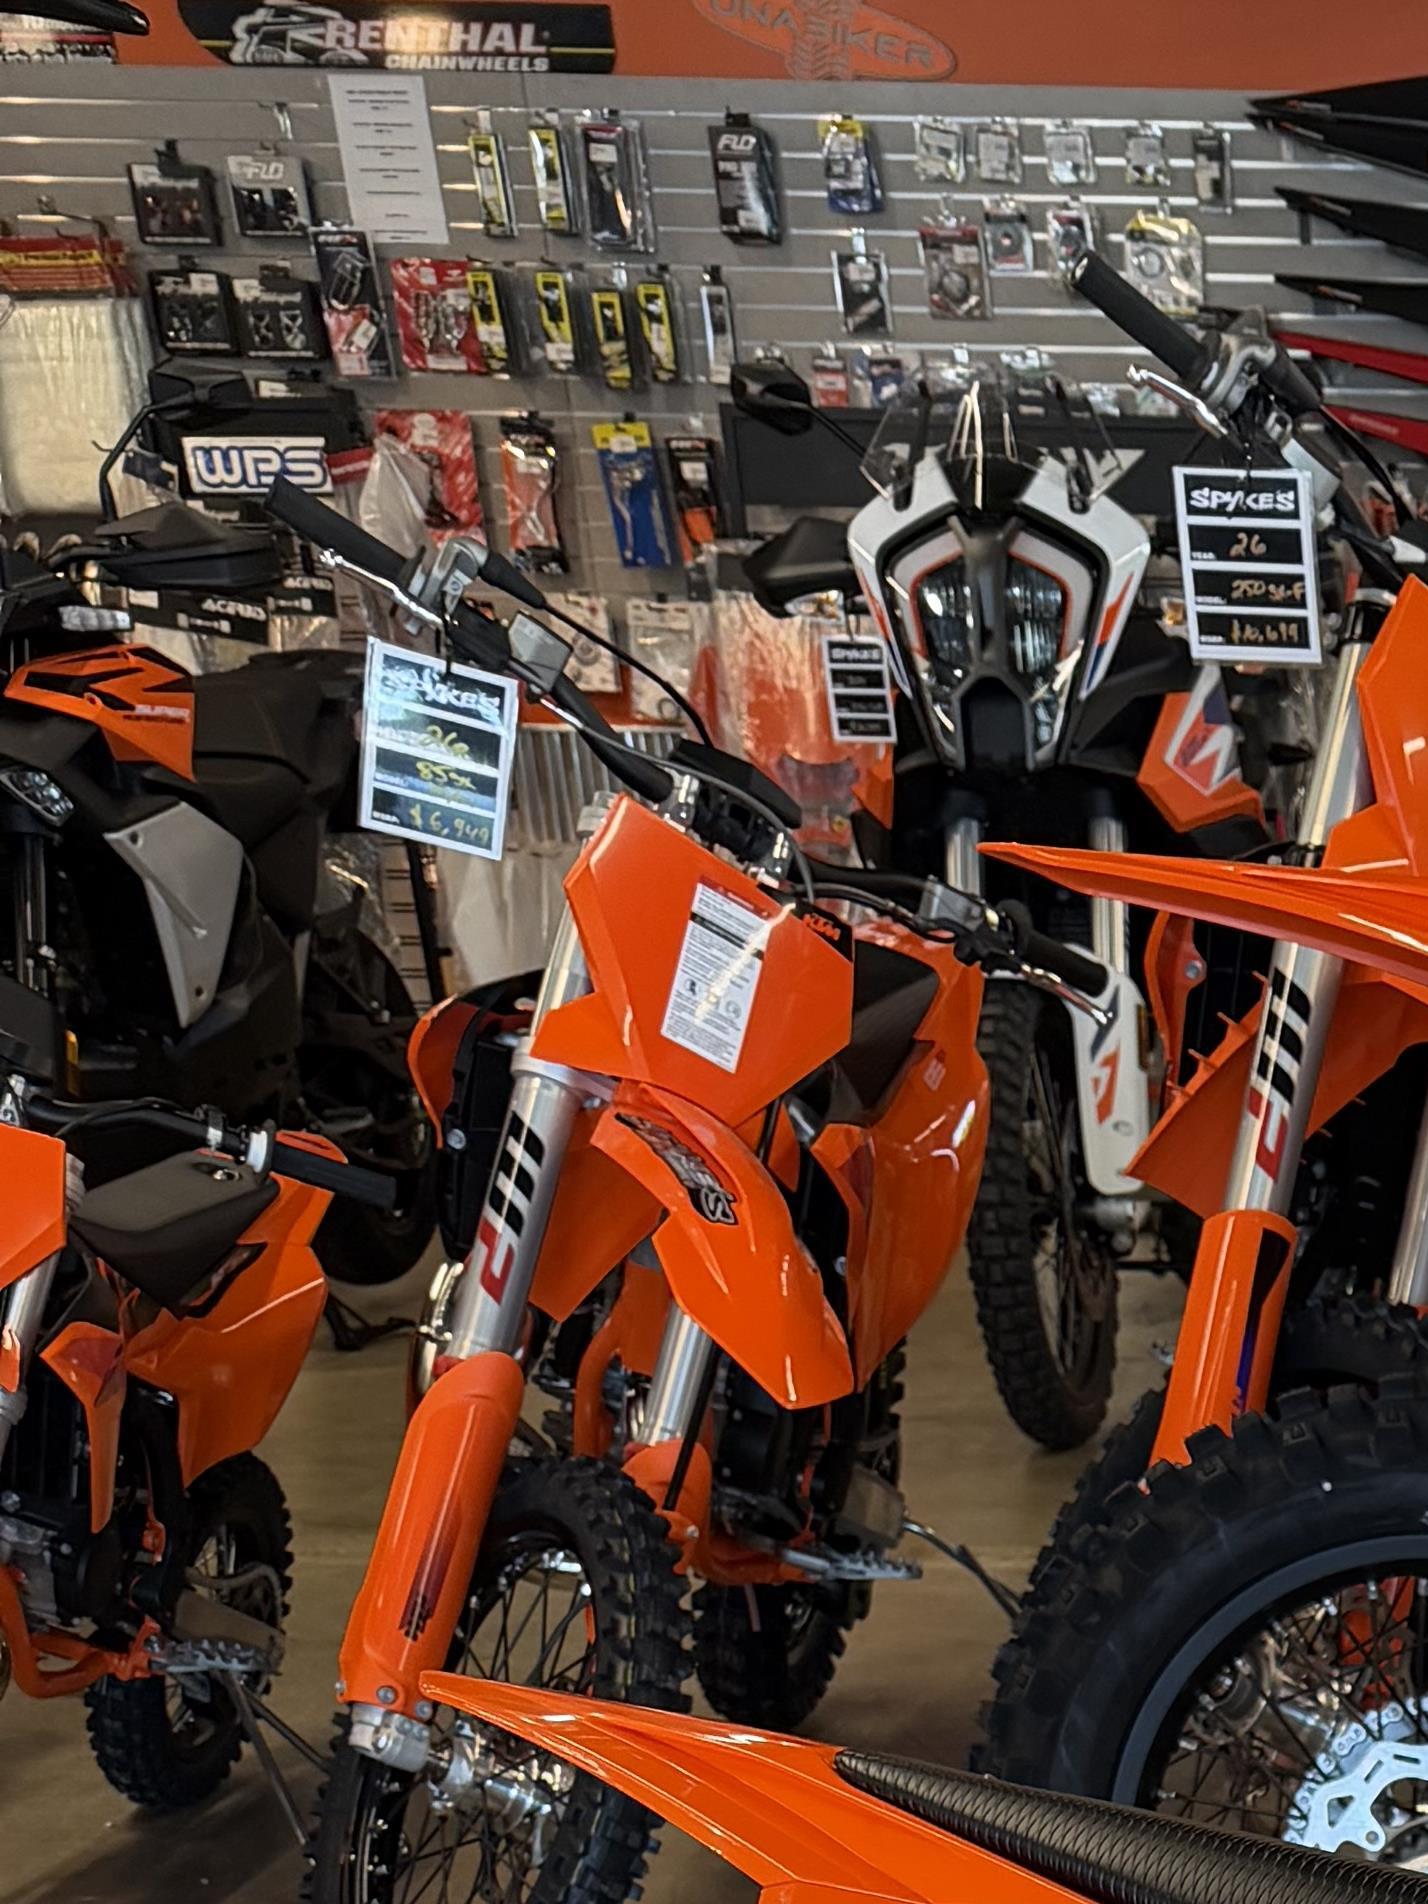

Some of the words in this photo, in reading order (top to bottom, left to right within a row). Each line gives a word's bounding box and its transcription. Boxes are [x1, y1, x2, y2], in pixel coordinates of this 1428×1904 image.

[323, 17, 547, 54] RENTHAL
[385, 54, 550, 72] CHAINWHEELS
[191, 446, 328, 488] WPS
[1229, 531, 1268, 558] 26
[415, 760, 455, 783] 85
[801, 911, 842, 942] KTM
